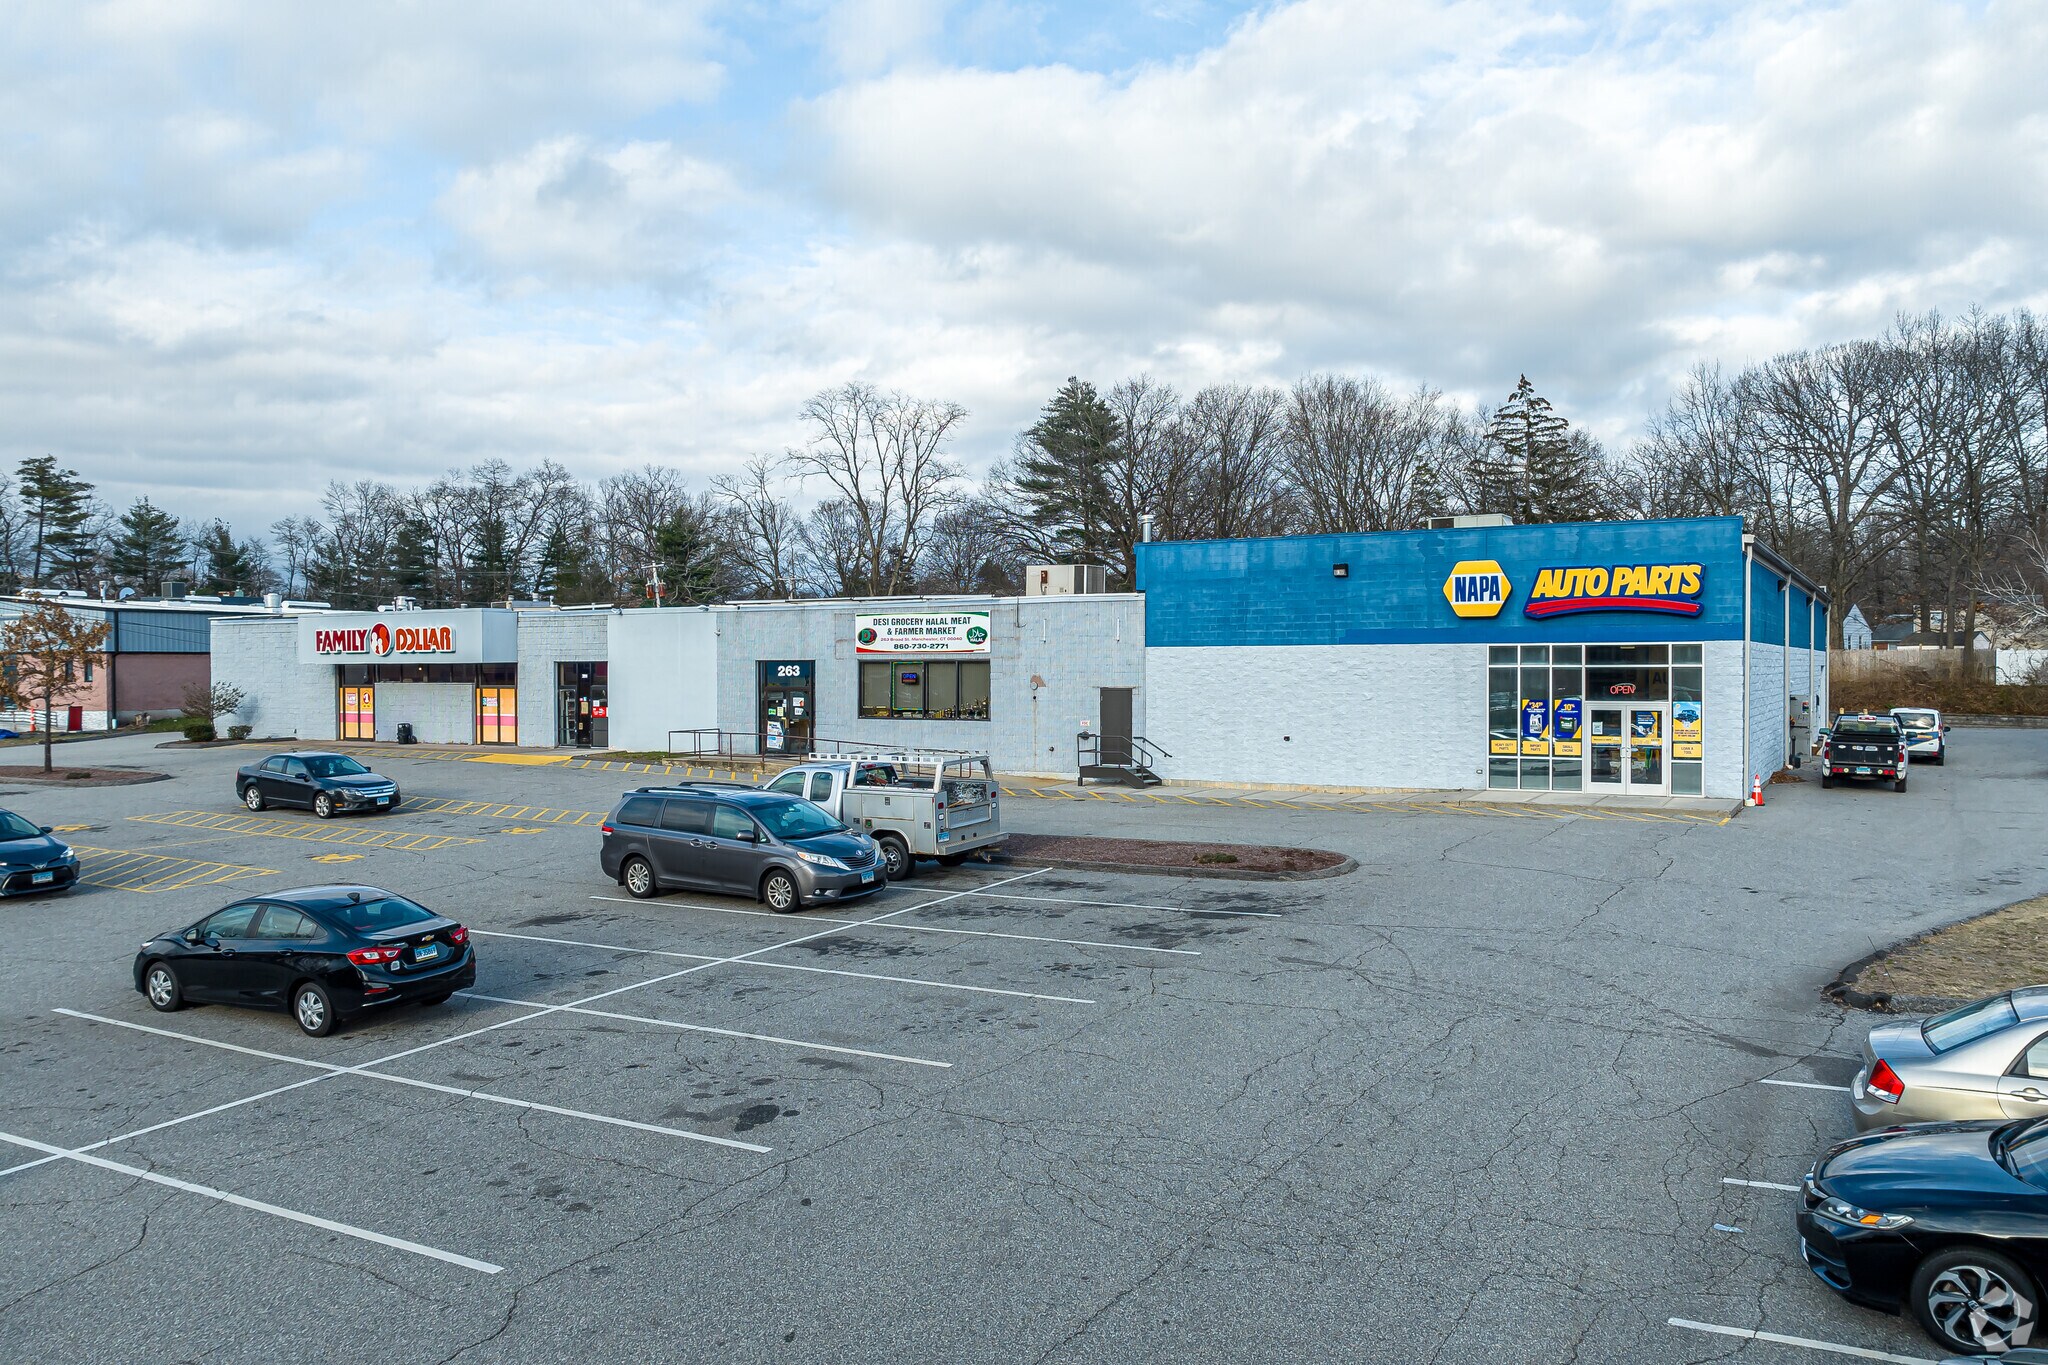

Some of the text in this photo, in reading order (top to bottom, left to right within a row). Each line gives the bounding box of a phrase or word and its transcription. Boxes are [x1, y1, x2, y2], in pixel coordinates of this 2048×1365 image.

[1531, 564, 1702, 599] AUTO PARTS
[1454, 575, 1501, 603] NAPA
[873, 616, 972, 626] DESI GROCERY HALAL MEAT
[886, 626, 956, 636] & FARMER MARKET
[315, 625, 452, 652] FAMILY DOLLAR
[777, 665, 801, 677] 263
[1609, 685, 1635, 695] OPEN
